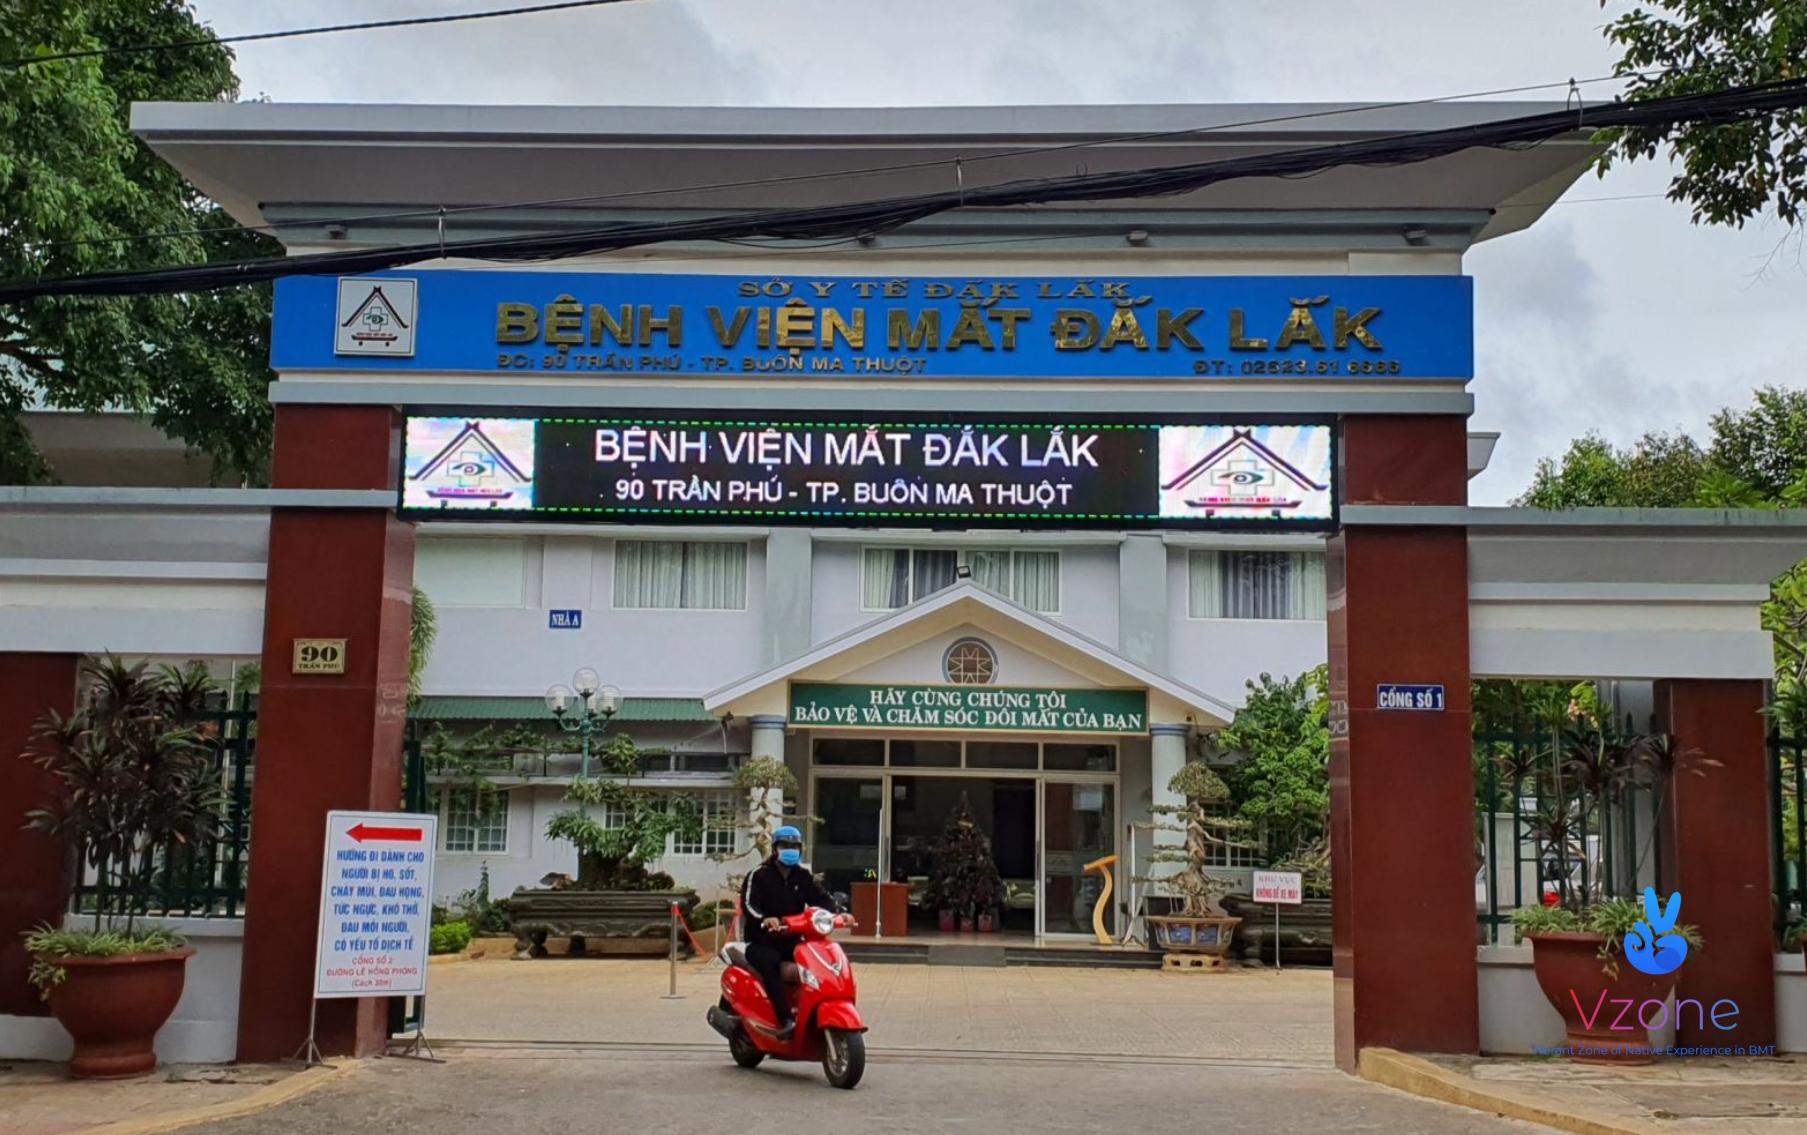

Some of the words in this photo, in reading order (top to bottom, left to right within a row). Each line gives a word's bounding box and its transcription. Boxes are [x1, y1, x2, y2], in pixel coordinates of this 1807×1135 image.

[738, 278, 793, 298] SỞ
[809, 281, 836, 298] Y
[852, 279, 908, 298] TẾ
[497, 294, 682, 352] BỆNH
[706, 298, 865, 356] VIỆN
[887, 297, 1031, 351] MẮT
[1051, 296, 1204, 351] ĐẮK
[1229, 296, 1383, 351] LẮK
[542, 354, 566, 369] 90
[640, 354, 682, 371] PHÚ
[812, 358, 844, 371] MA
[853, 358, 927, 375] THUỘT
[595, 426, 707, 469] BỆNH
[719, 429, 812, 471] VIỆN
[824, 425, 911, 465] MẮT
[923, 425, 1009, 466] ĐẮK
[1021, 425, 1099, 466] LẮK
[616, 479, 644, 500] 90
[653, 474, 720, 501] TRẦN
[729, 475, 782, 501] PHÚ
[806, 482, 846, 503] TP.
[854, 478, 928, 503] BUÔN
[936, 484, 974, 504] MA
[982, 480, 1073, 509] THUỘT
[572, 614, 579, 626] A
[301, 646, 338, 662] 90
[870, 688, 907, 704] HÃY
[912, 688, 961, 706] CÙNG
[968, 691, 1030, 708] CHÚNG
[1036, 692, 1066, 708] TÔI
[1380, 686, 1413, 707] CỔNG
[1416, 688, 1433, 708] SỐ
[1436, 692, 1442, 708] 1
[795, 701, 829, 721] BẢO
[834, 704, 857, 724] VỆ
[862, 705, 882, 723] VÀ
[887, 706, 940, 724] CHĂM
[944, 707, 979, 725] SÓC
[985, 708, 1017, 725] ĐÔI
[1022, 708, 1059, 727] MẮT
[1063, 707, 1098, 728] CỦA
[1103, 713, 1142, 731] BẠN
[369, 851, 378, 862] ĐI
[381, 849, 404, 862] DÀNH
[407, 852, 424, 862] CHO
[371, 868, 379, 881] BỊ
[399, 865, 417, 881] SỐT,
[379, 887, 396, 897] ĐAU
[341, 922, 359, 933] ĐAU
[381, 939, 401, 953] DỊCH
